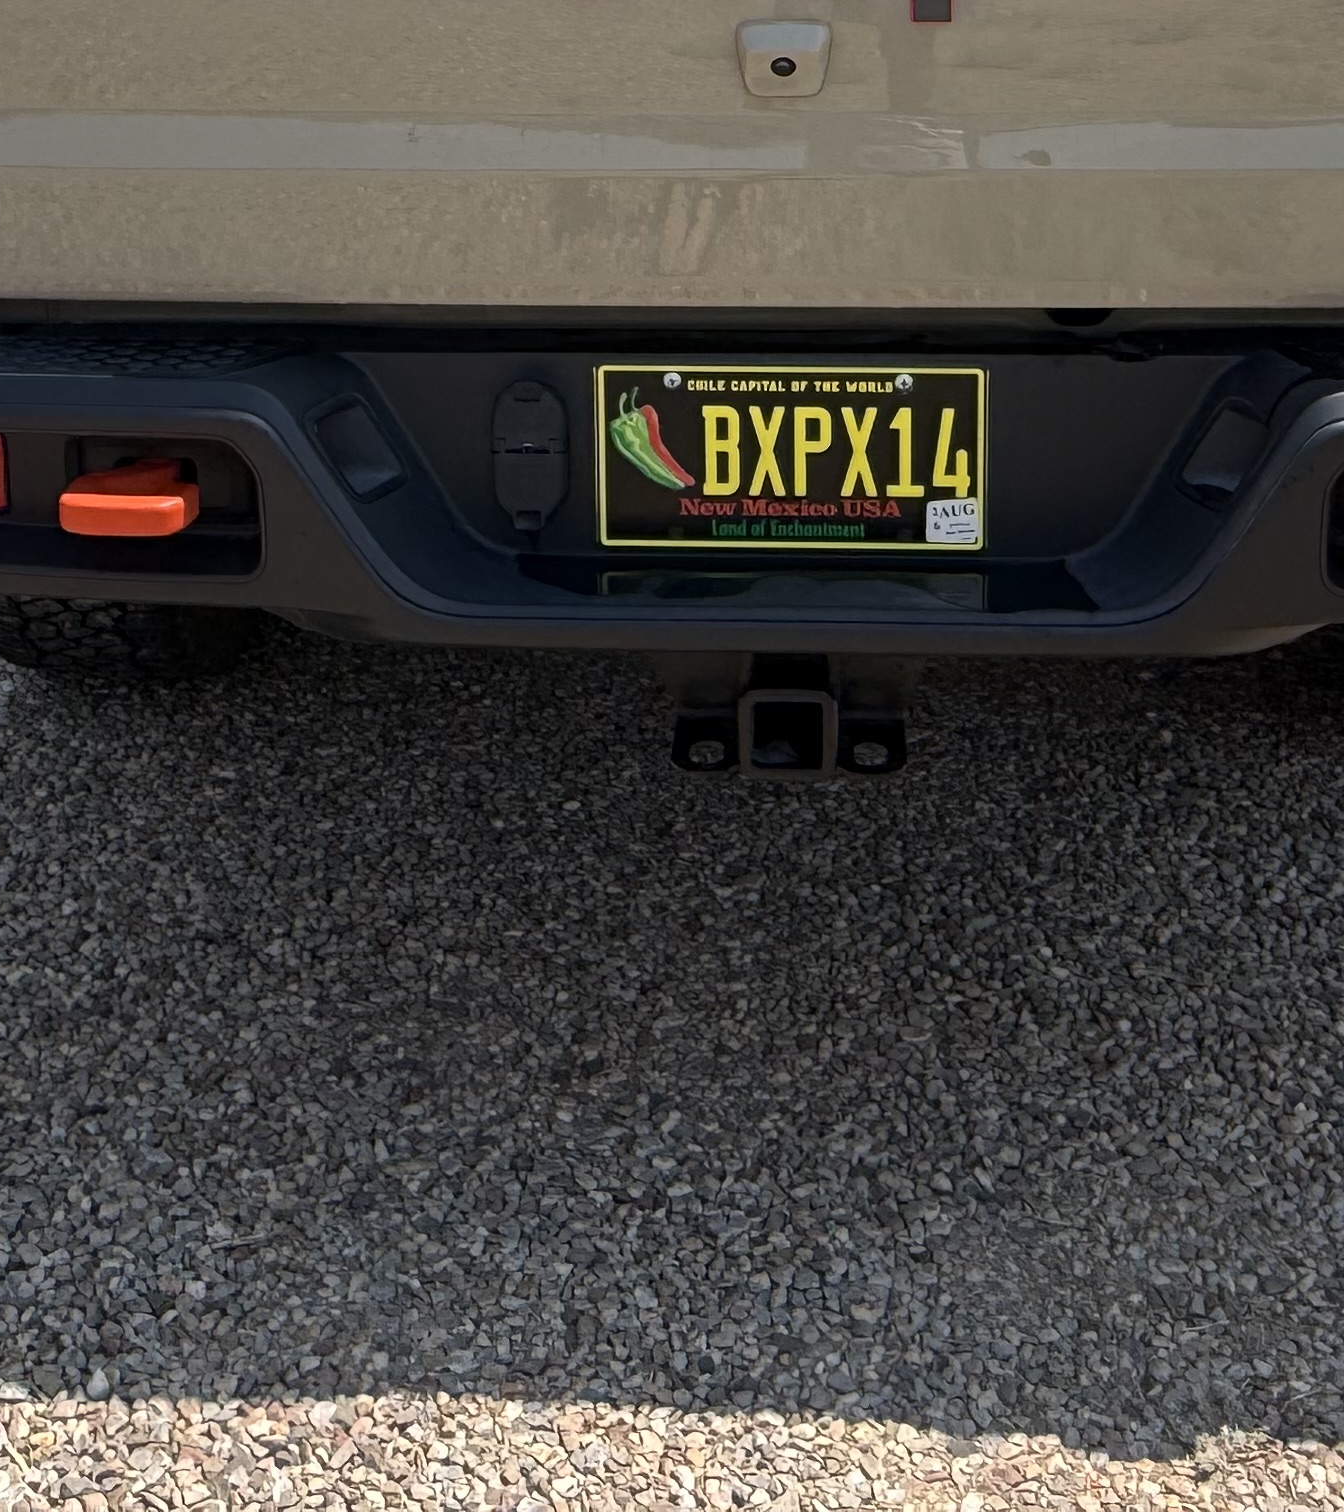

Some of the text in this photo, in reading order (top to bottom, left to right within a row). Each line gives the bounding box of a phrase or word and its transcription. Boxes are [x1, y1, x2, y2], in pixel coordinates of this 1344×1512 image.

[687, 380, 894, 393] CHILE CAPITAL OF THE WORLD
[702, 405, 971, 497] BXPX14
[679, 498, 902, 518] New Mexico USA
[939, 503, 975, 519] AUG
[711, 519, 866, 538] Land of Enchantment
